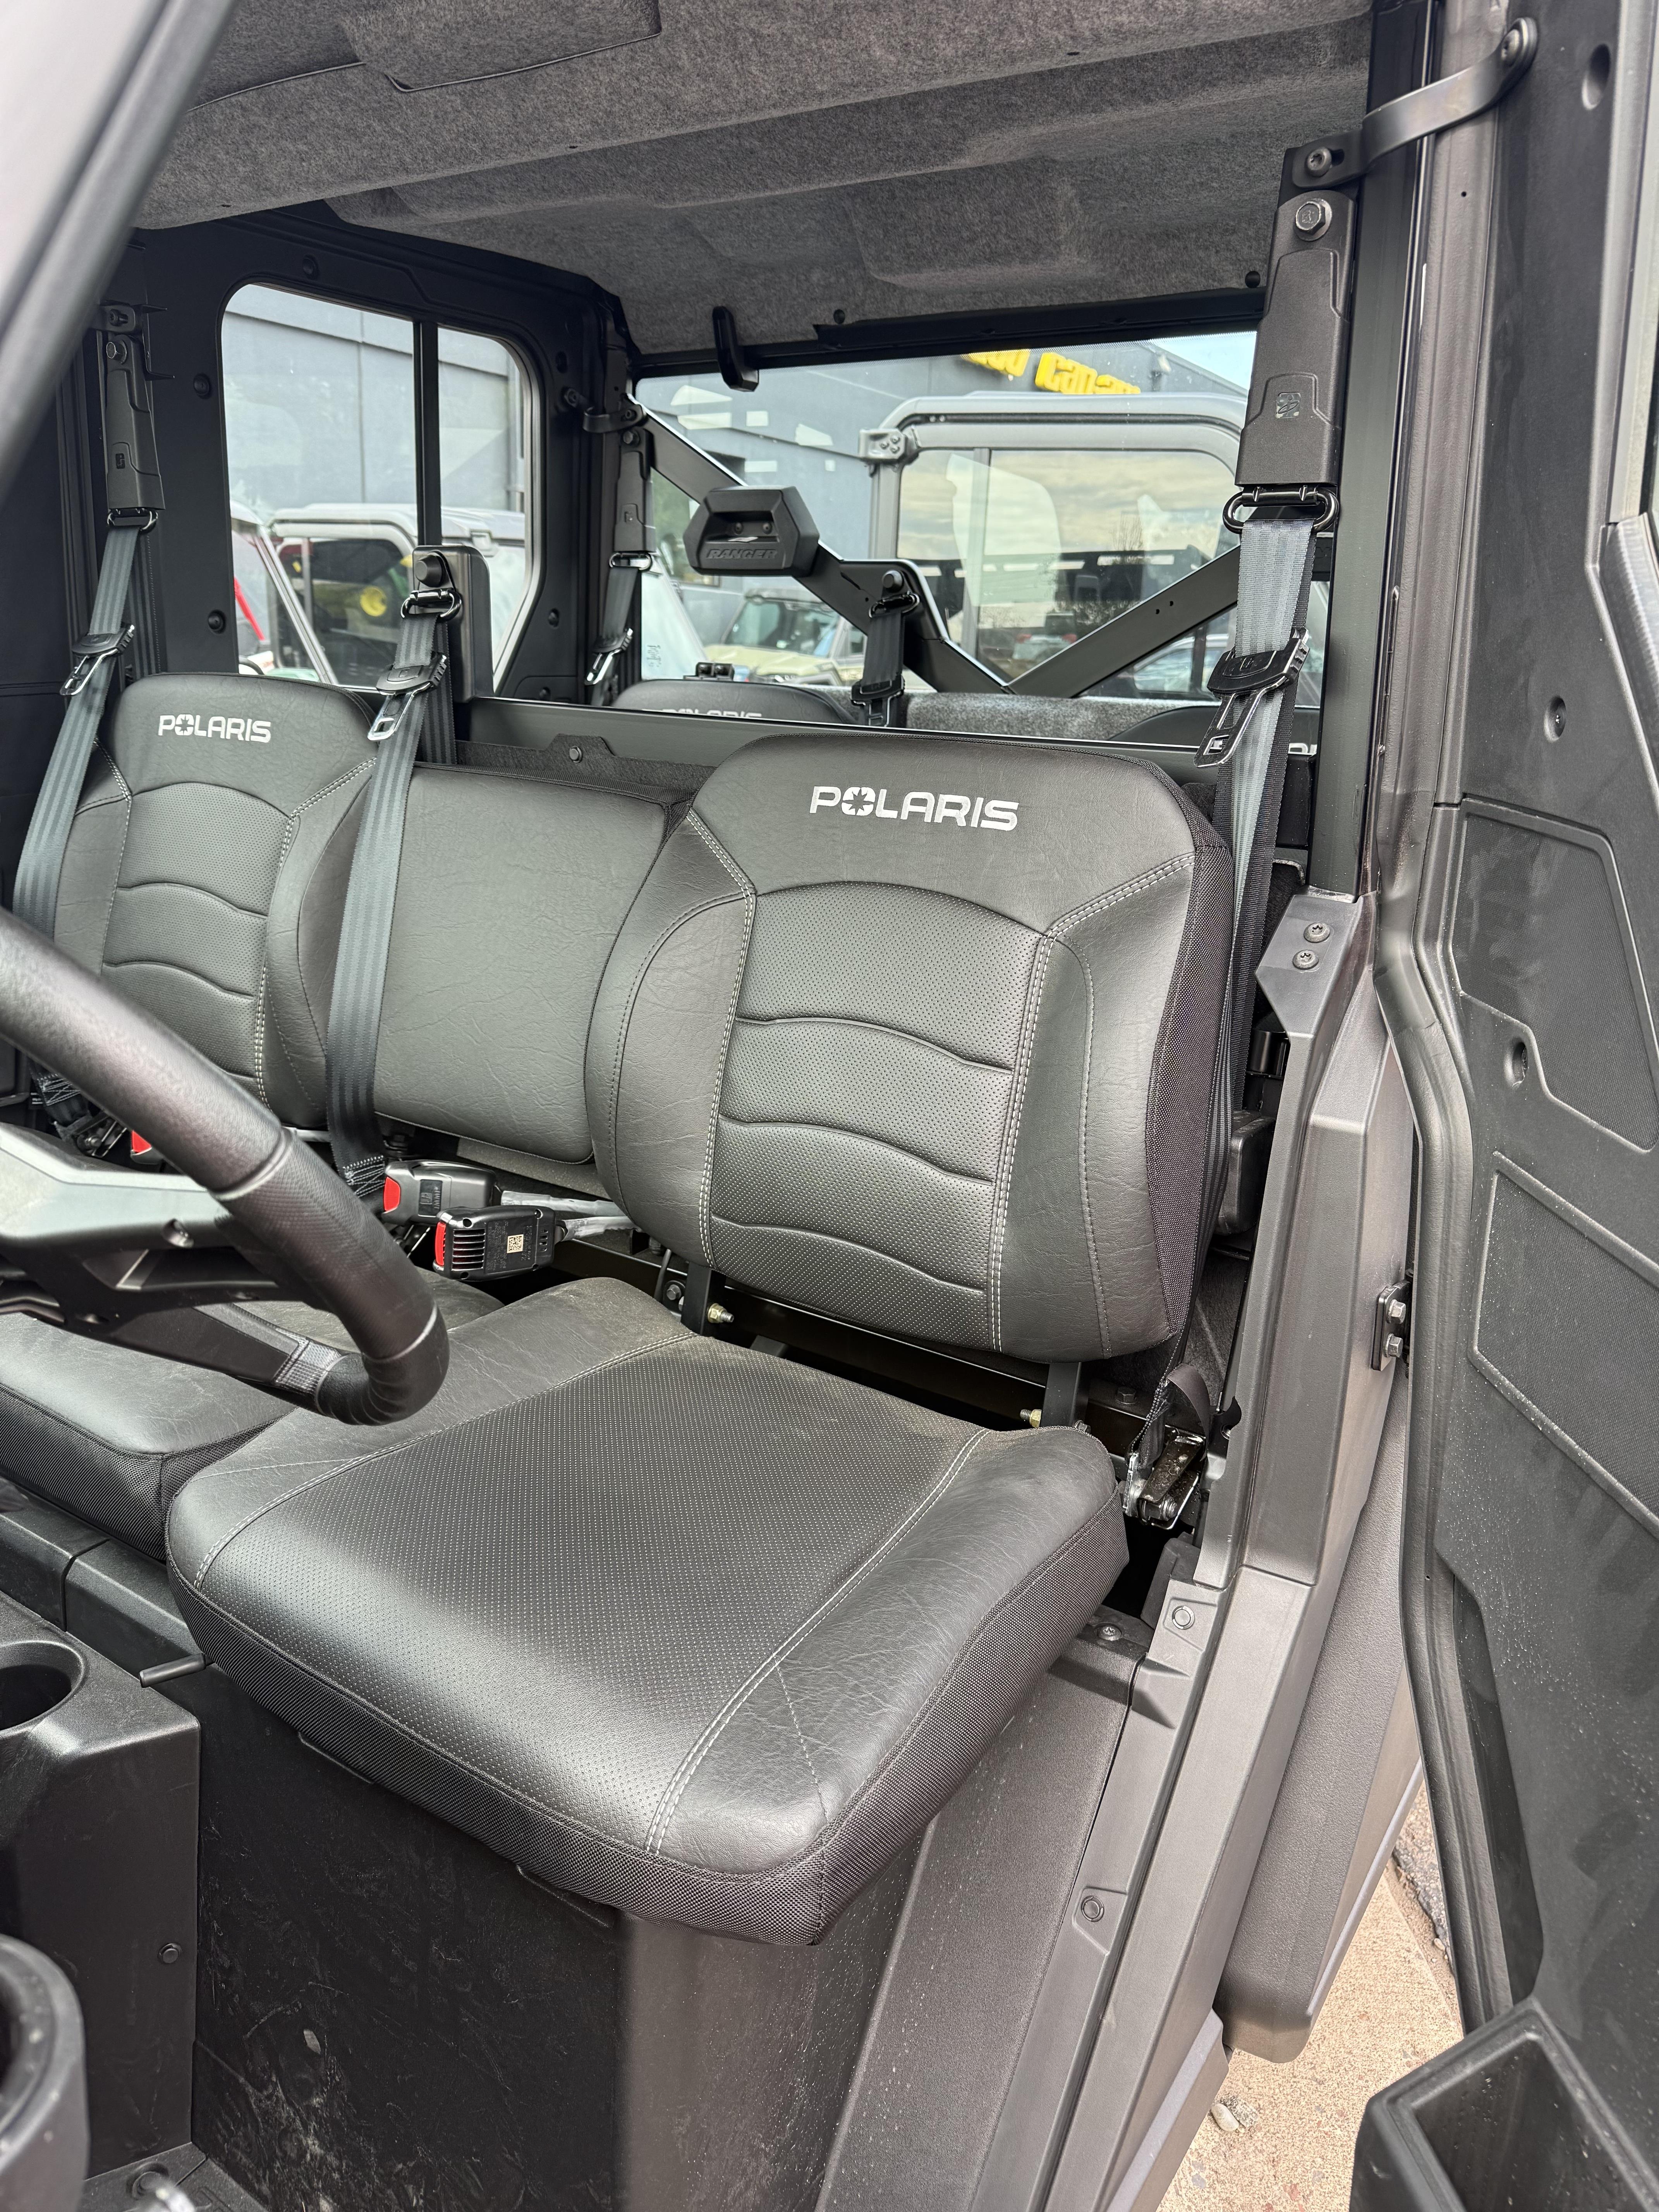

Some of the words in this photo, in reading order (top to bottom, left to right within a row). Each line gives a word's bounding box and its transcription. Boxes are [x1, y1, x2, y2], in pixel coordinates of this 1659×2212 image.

[706, 549, 777, 559] RANGER
[158, 714, 271, 743] POLARIS
[809, 786, 1019, 831] POLARIS
